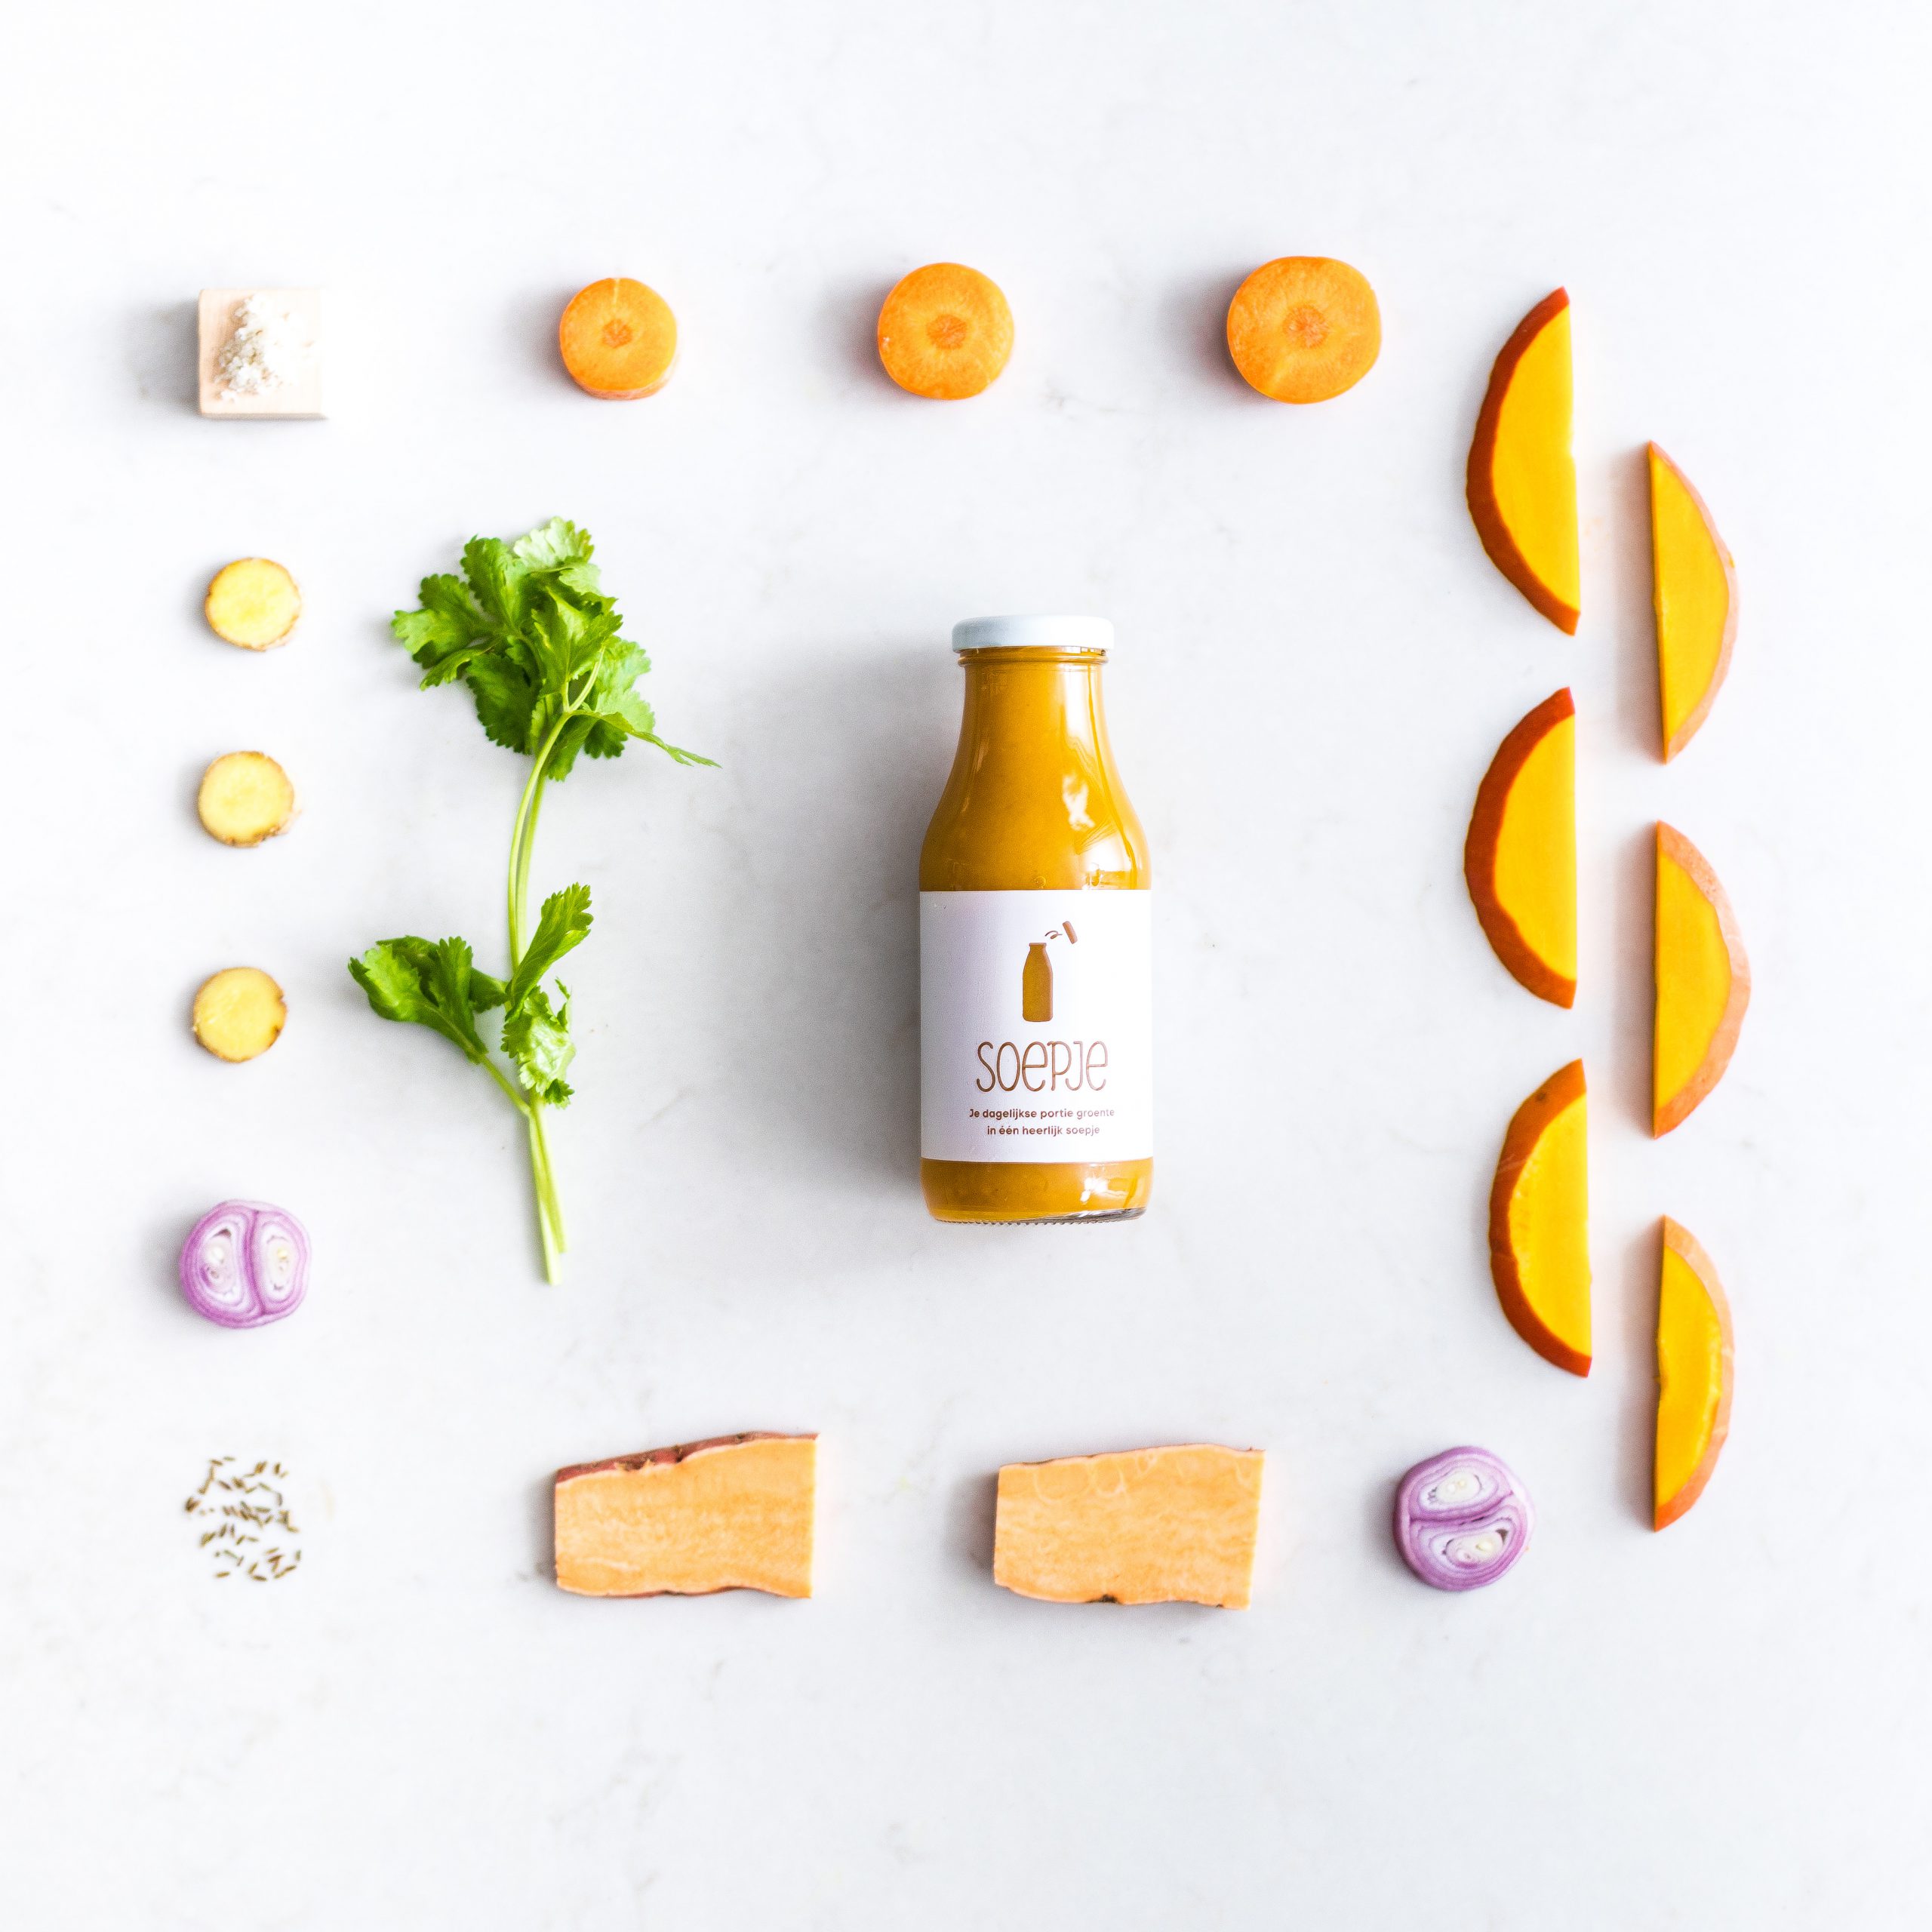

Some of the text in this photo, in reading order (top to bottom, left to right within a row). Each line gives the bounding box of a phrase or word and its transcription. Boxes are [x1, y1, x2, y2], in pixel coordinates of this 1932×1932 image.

[969, 1108, 1115, 1121] Je dagelijkse portie groente
[986, 1124, 1100, 1137] in één heerlijk soepje
